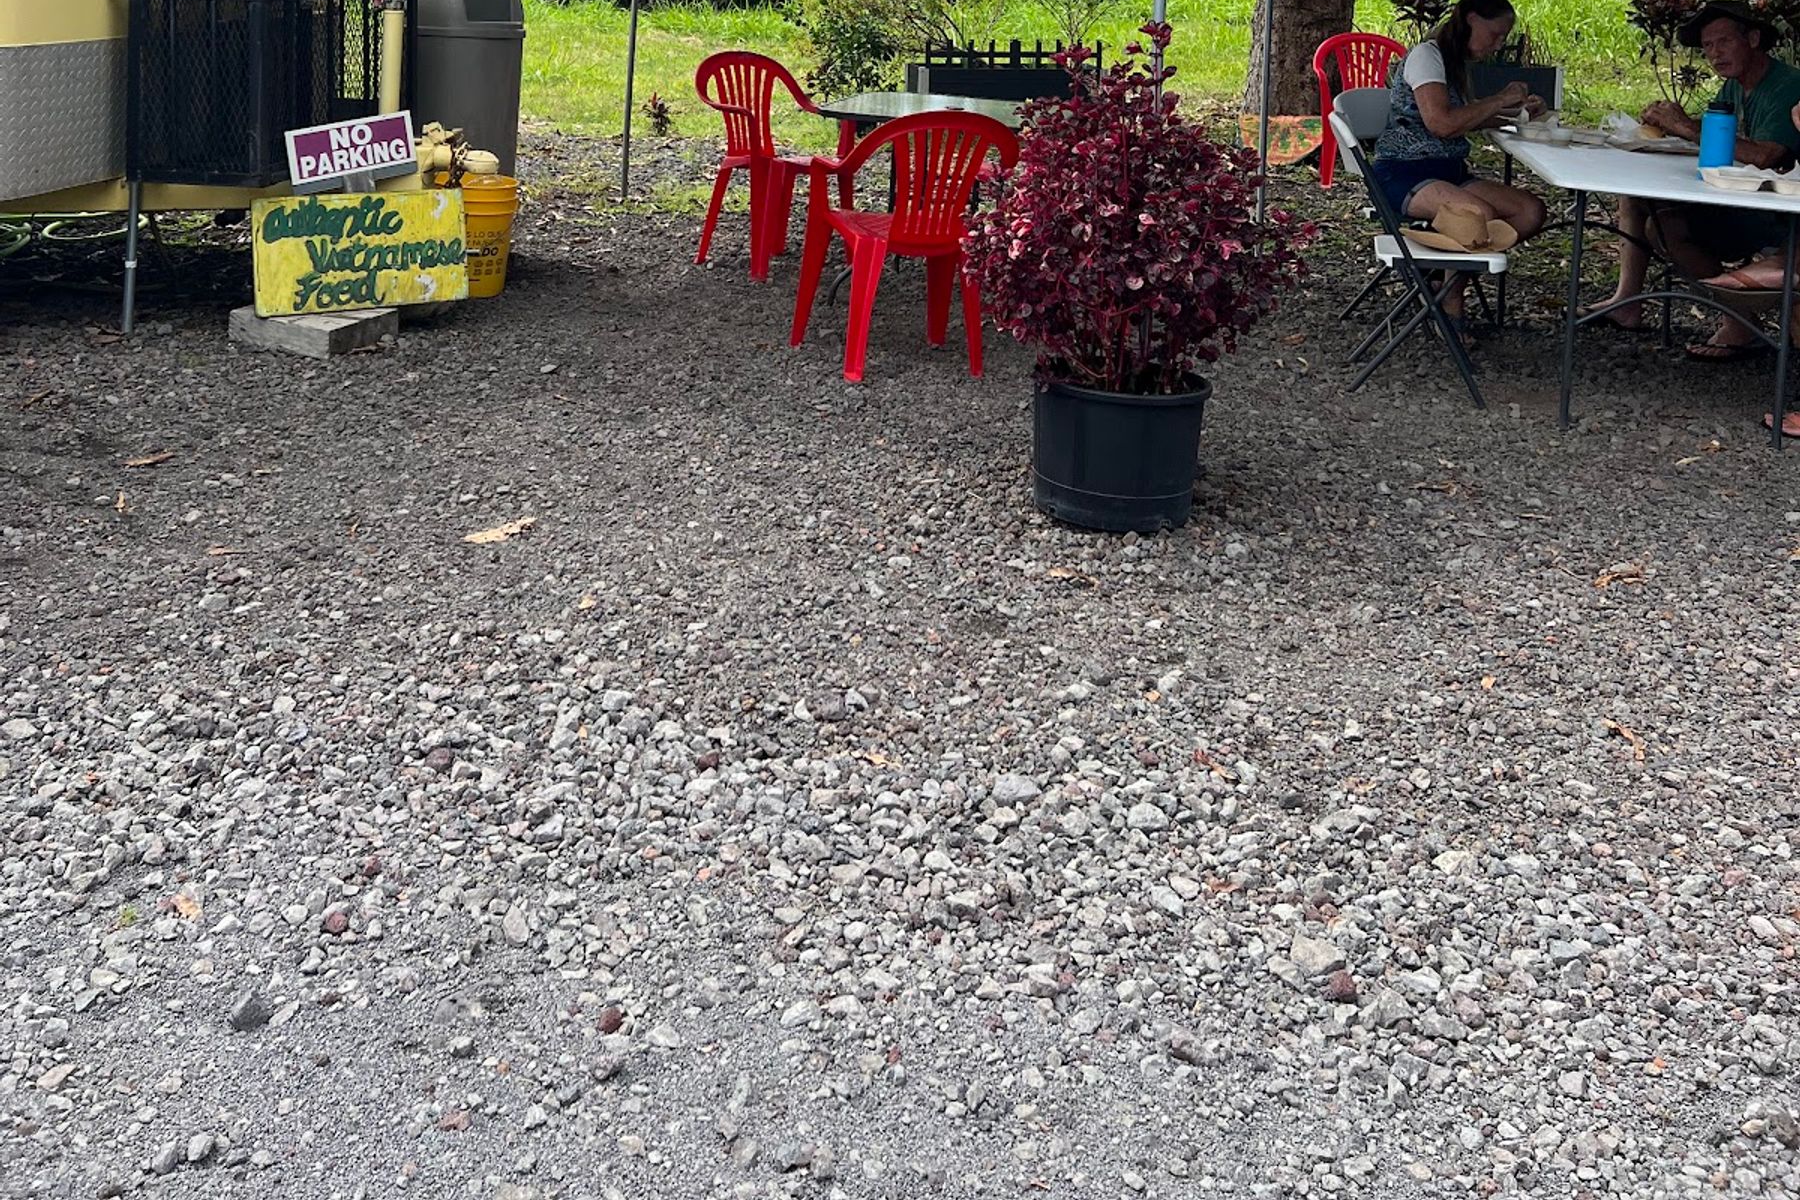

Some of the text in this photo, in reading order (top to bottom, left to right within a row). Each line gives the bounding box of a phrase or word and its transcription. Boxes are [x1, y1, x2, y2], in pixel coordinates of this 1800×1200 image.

[329, 124, 373, 150] NO
[300, 138, 408, 178] PARKING
[305, 237, 466, 274] Vietnamese
